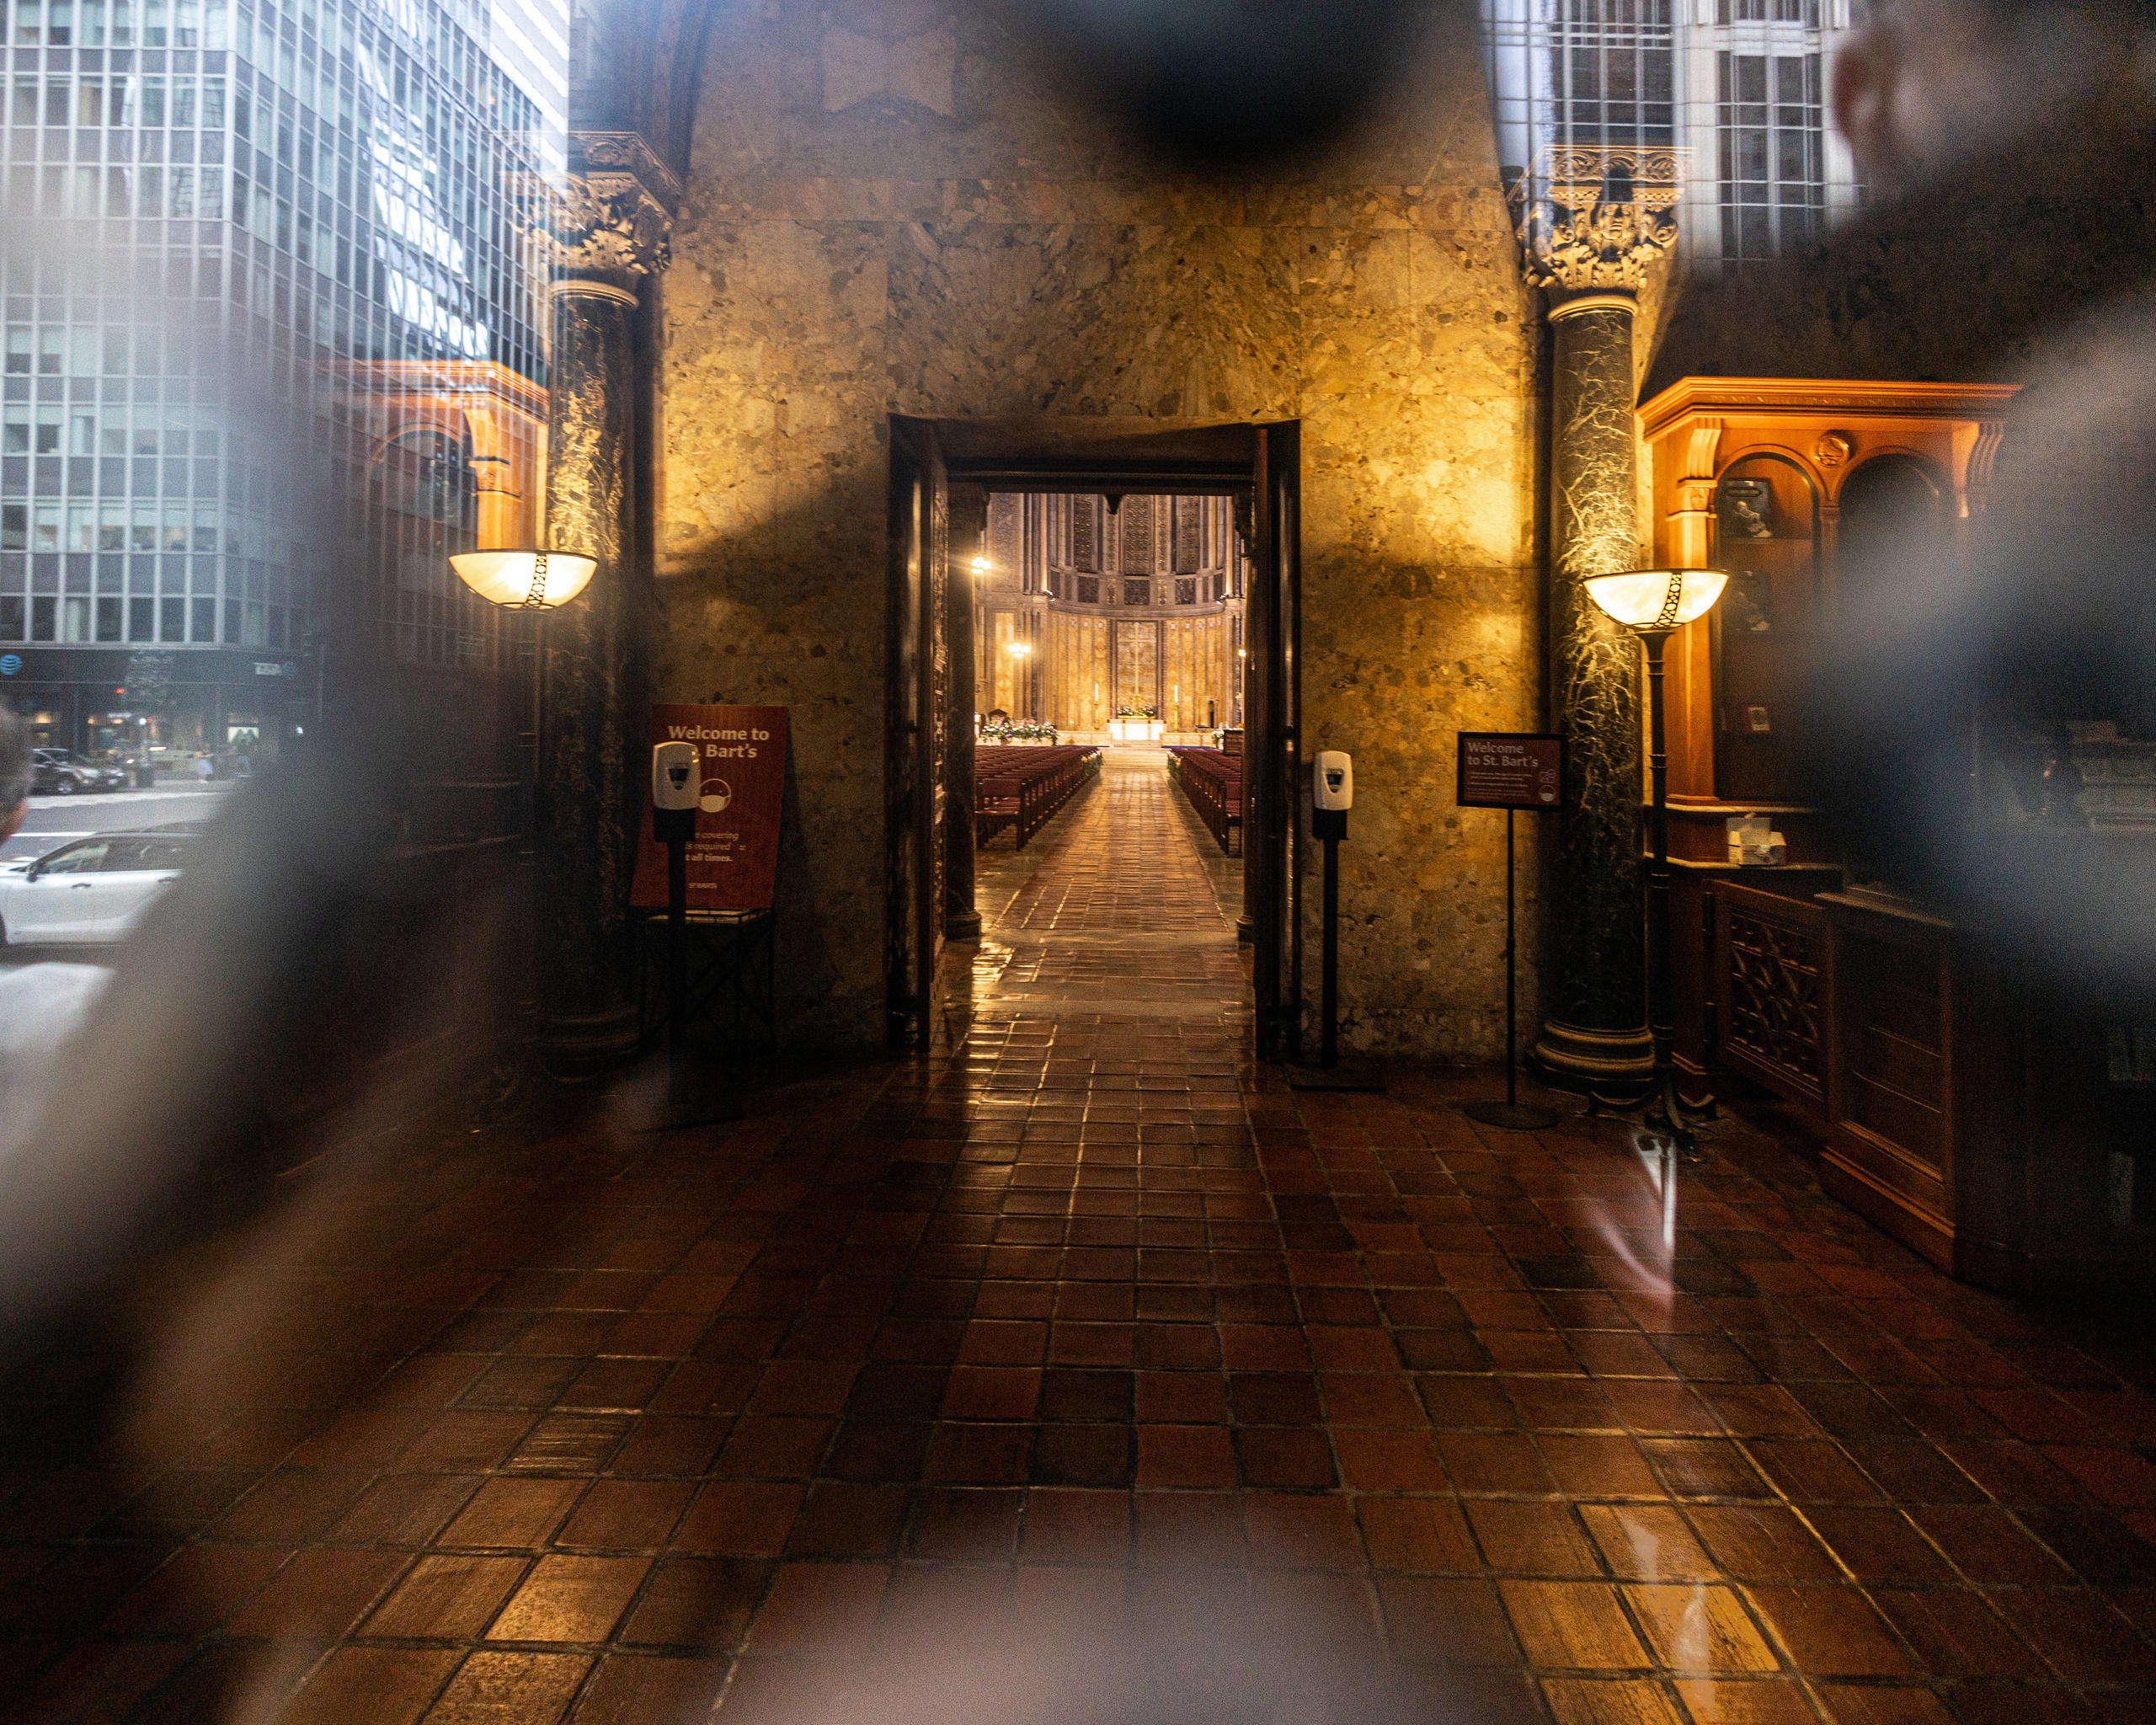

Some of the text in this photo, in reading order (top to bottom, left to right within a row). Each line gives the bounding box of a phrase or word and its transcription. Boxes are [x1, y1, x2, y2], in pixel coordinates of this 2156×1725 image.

[668, 725, 770, 740] Welcome to
[706, 744, 757, 758] Bart's
[1467, 741, 1524, 754] Welcome
[1468, 755, 1539, 767] to St. Bart's
[701, 831, 739, 841] covering
[694, 841, 731, 852] required
[691, 852, 703, 862] all
[704, 852, 734, 862] times.
